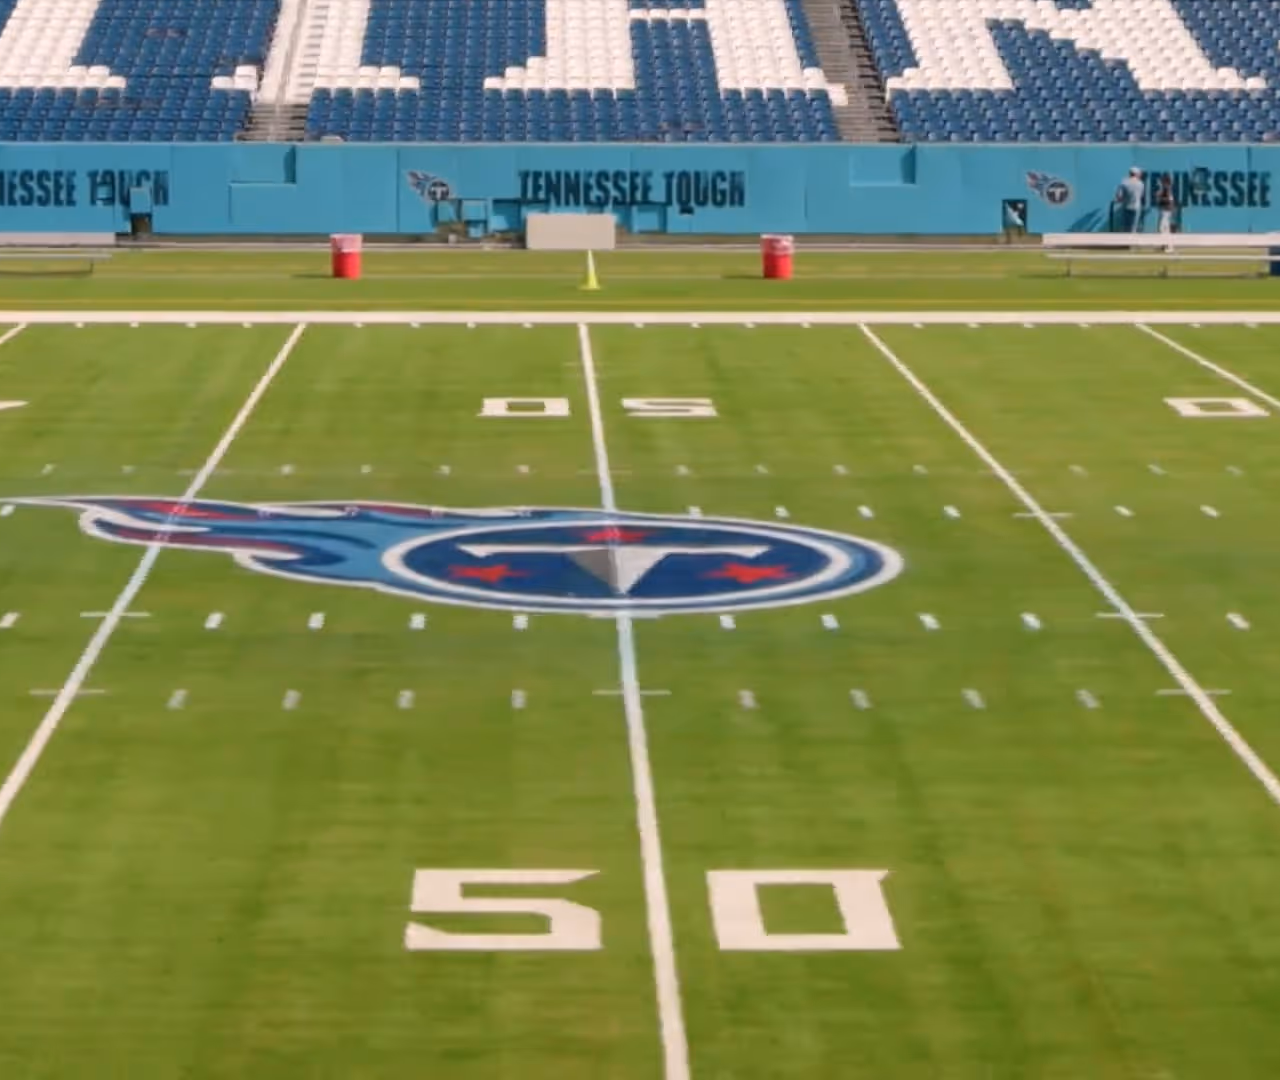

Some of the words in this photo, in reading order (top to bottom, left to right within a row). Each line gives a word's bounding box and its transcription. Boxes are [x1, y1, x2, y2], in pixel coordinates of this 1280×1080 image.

[519, 170, 651, 206] TENNESSEE
[664, 170, 746, 207] TOUGH
[404, 868, 902, 951] 50
